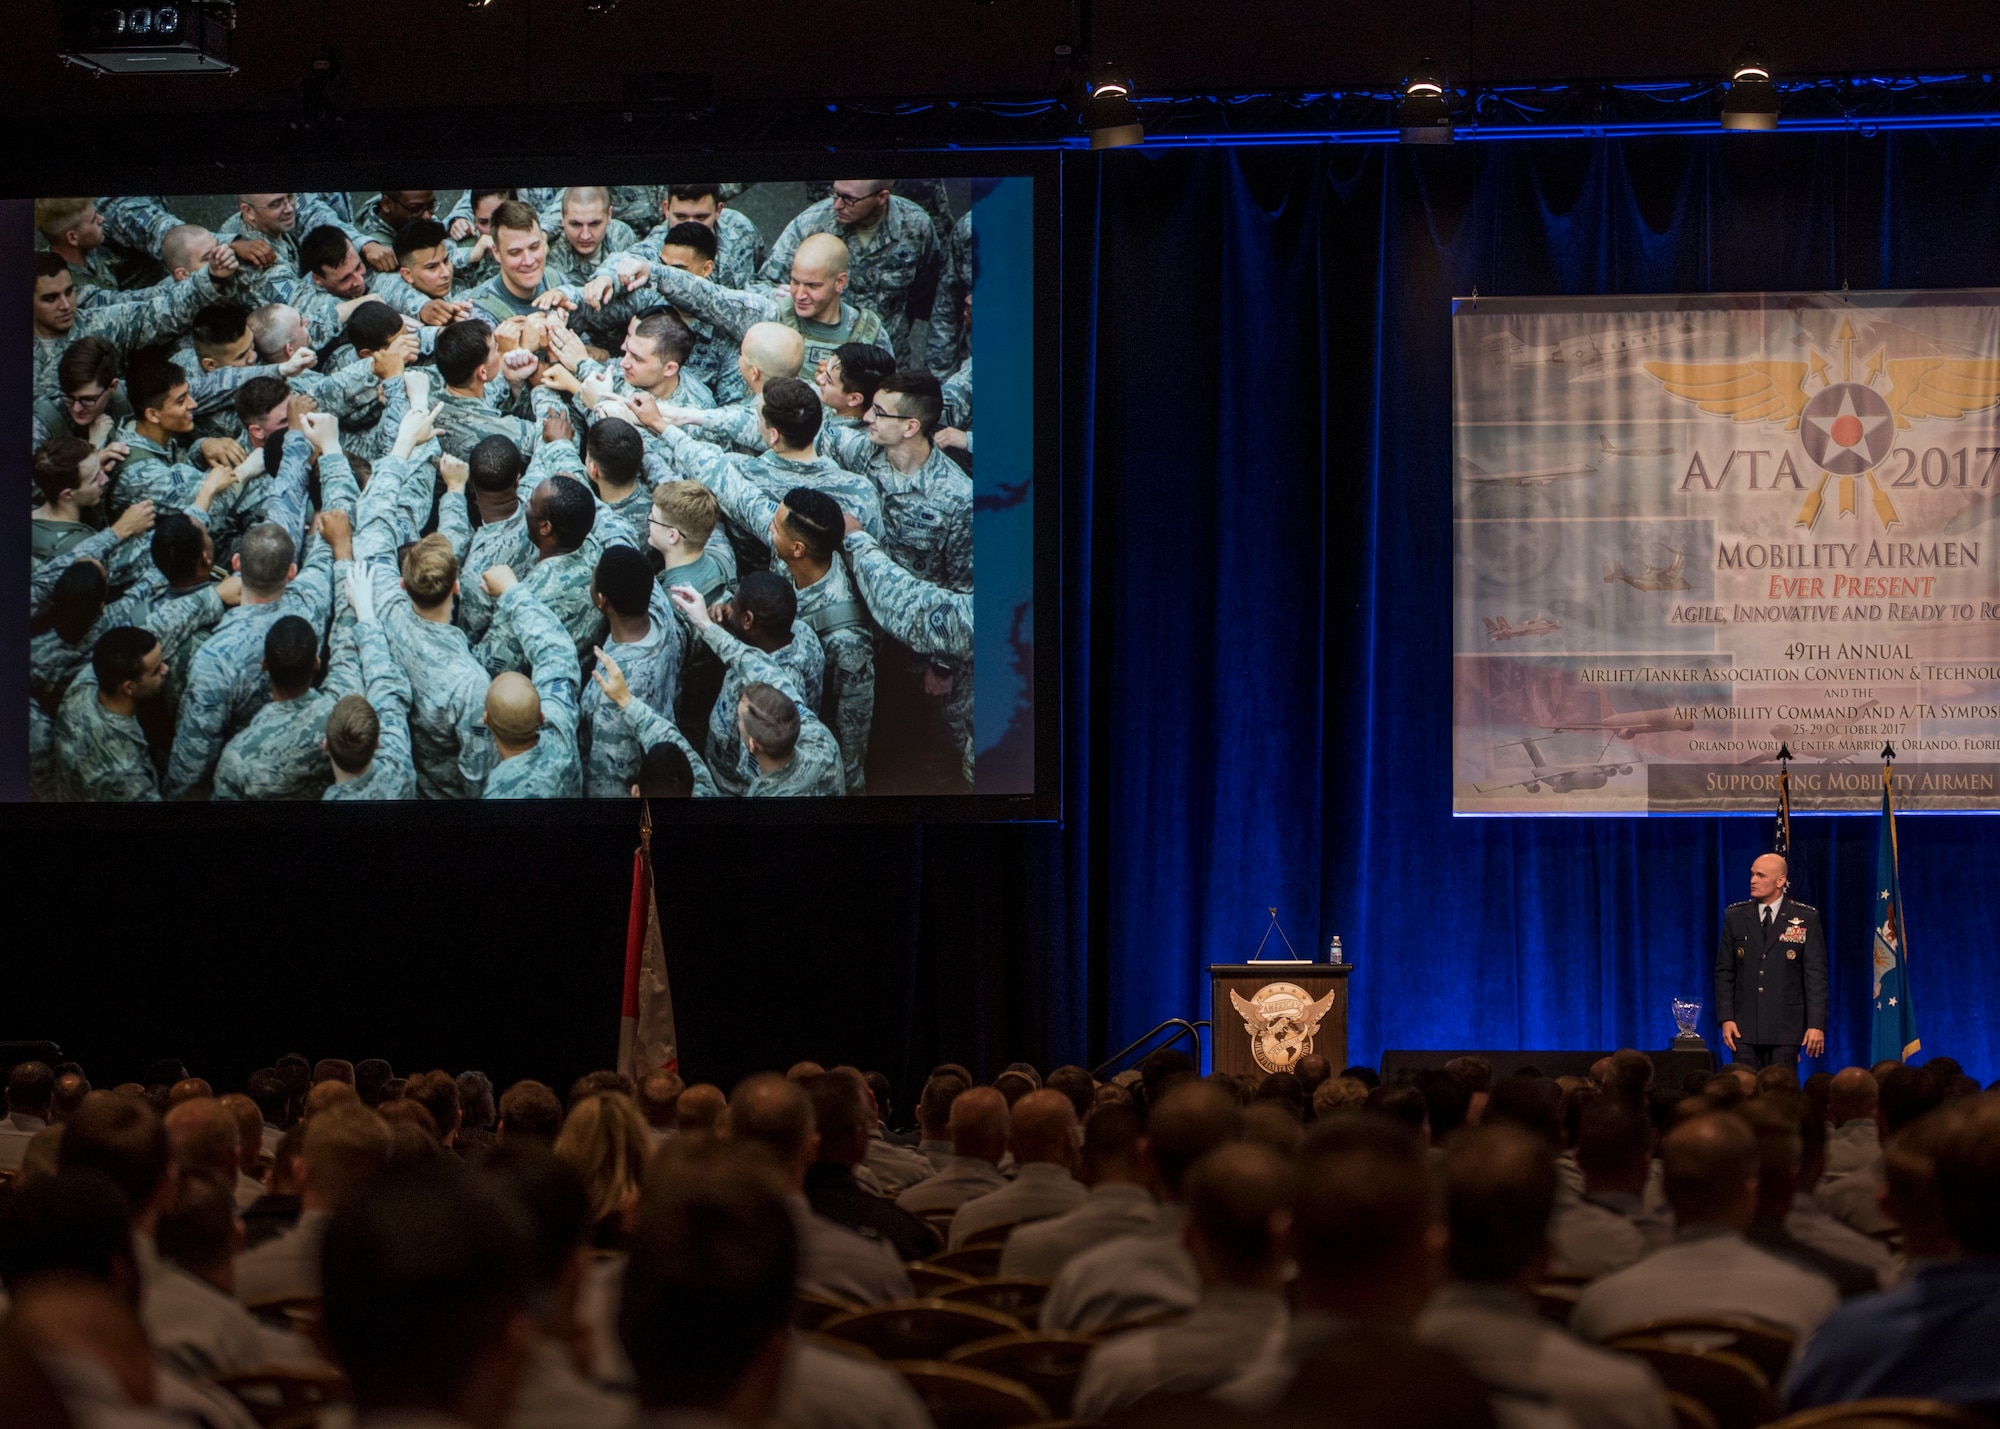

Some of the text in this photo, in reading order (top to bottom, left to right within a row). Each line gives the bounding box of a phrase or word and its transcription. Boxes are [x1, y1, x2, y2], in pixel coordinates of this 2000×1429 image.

[1680, 447, 2000, 490] A/TA 2017
[1717, 539, 1980, 569] MOBILITY AIRMEN
[1768, 574, 1936, 598] EVER PRESENT
[1672, 604, 1727, 624] AGILE,
[1733, 603, 1838, 622] INNOVATIVE
[1842, 603, 1881, 621] AND
[1888, 602, 1946, 621] READY
[1950, 602, 1975, 621] TO
[1784, 642, 1913, 660] 49TH ANNUAL
[1580, 668, 1699, 682] AIRLIFT/TANKER
[1702, 667, 1799, 681] ASSOCIATION
[1804, 666, 1904, 681] CONVENTION
[1909, 666, 1921, 680] &
[1824, 688, 1874, 698] AND THE
[1673, 706, 1699, 720] AIR
[1702, 705, 1773, 720] MOBILITY
[1777, 705, 1858, 719] COMMAND
[1862, 706, 1895, 719] AND
[1899, 704, 1936, 719] A/TA
[1793, 723, 1906, 735] 25-29 OCTOBER 2017
[1689, 740, 1744, 751] ORLANDO
[1792, 739, 1834, 750] CENTER
[1706, 772, 1994, 791] SUPPORING MOBILTY AIRMEN
